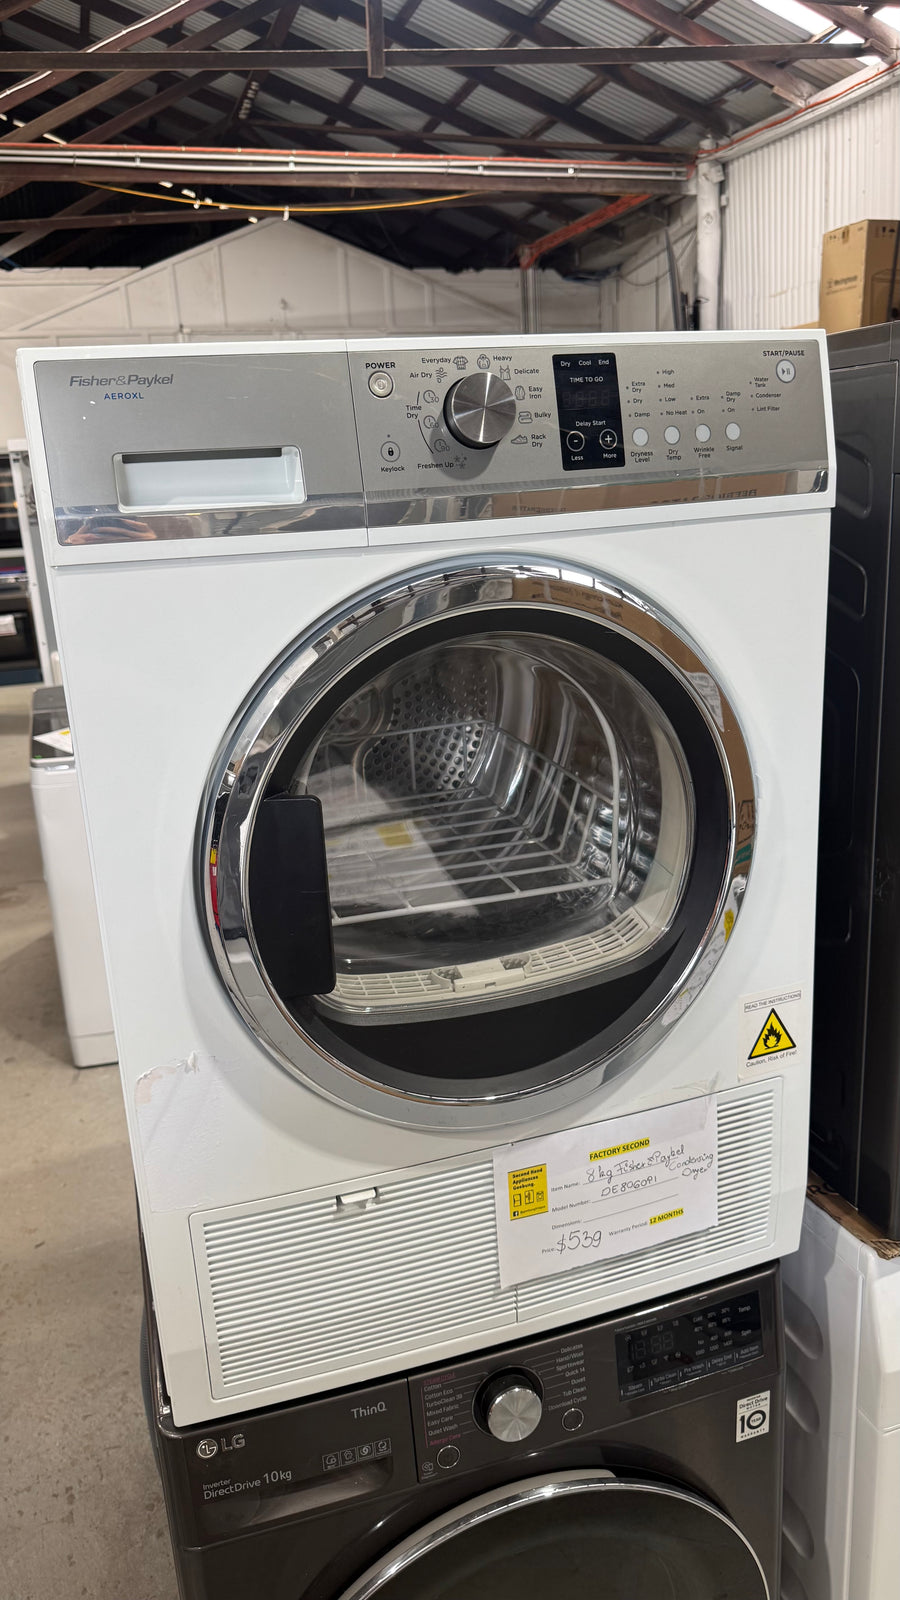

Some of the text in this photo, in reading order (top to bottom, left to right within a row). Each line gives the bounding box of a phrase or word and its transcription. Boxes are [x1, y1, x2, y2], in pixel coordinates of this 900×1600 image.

[421, 356, 451, 365] Everyday
[69, 374, 174, 388] Fisher&Paykel
[528, 386, 543, 394] Easy
[104, 392, 144, 400] AEROXL
[381, 465, 405, 473] Keylock
[768, 993, 800, 1004] INSTRUCTIONS
[589, 1138, 650, 1160] FACTORY SECOND
[552, 1204, 568, 1212] Model
[569, 1200, 591, 1208] Number:
[551, 1219, 582, 1230] Dimensions:
[609, 1226, 631, 1236] Warranty
[632, 1221, 648, 1230] Period:
[658, 1209, 684, 1222] MONTHS
[556, 1230, 602, 1254] $539
[565, 1369, 579, 1377] Quick
[571, 1376, 586, 1385] Duvet
[424, 1384, 442, 1392] Cotton
[425, 1392, 442, 1400] Cotton
[574, 1395, 587, 1404] Cycle
[351, 1401, 387, 1419] ThinQ
[443, 1404, 459, 1412] Fabric
[739, 1410, 766, 1434] 10
[428, 1424, 458, 1436] Quiet Wash
[220, 1433, 245, 1452] LG
[203, 1478, 231, 1491] Inverter
